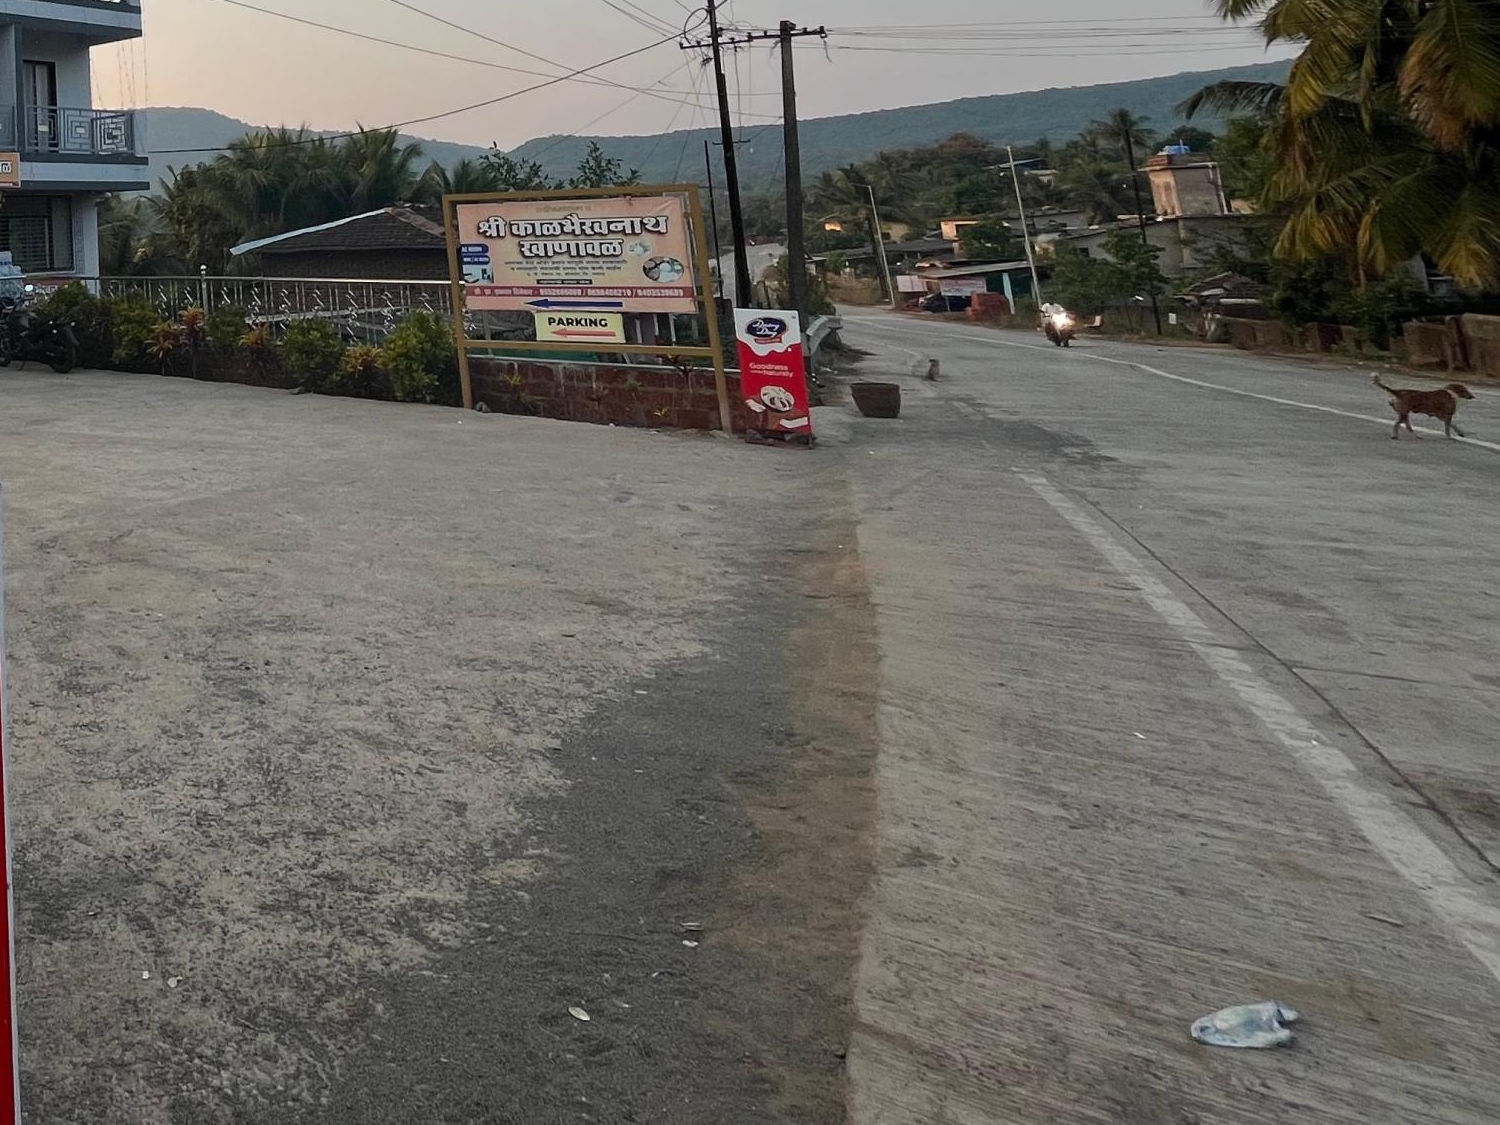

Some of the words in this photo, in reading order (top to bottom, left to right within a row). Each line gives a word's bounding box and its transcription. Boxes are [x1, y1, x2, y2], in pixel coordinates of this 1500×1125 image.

[477, 215, 507, 238] श्री
[519, 238, 624, 258] खाणावळ
[547, 316, 609, 328] PARKING
